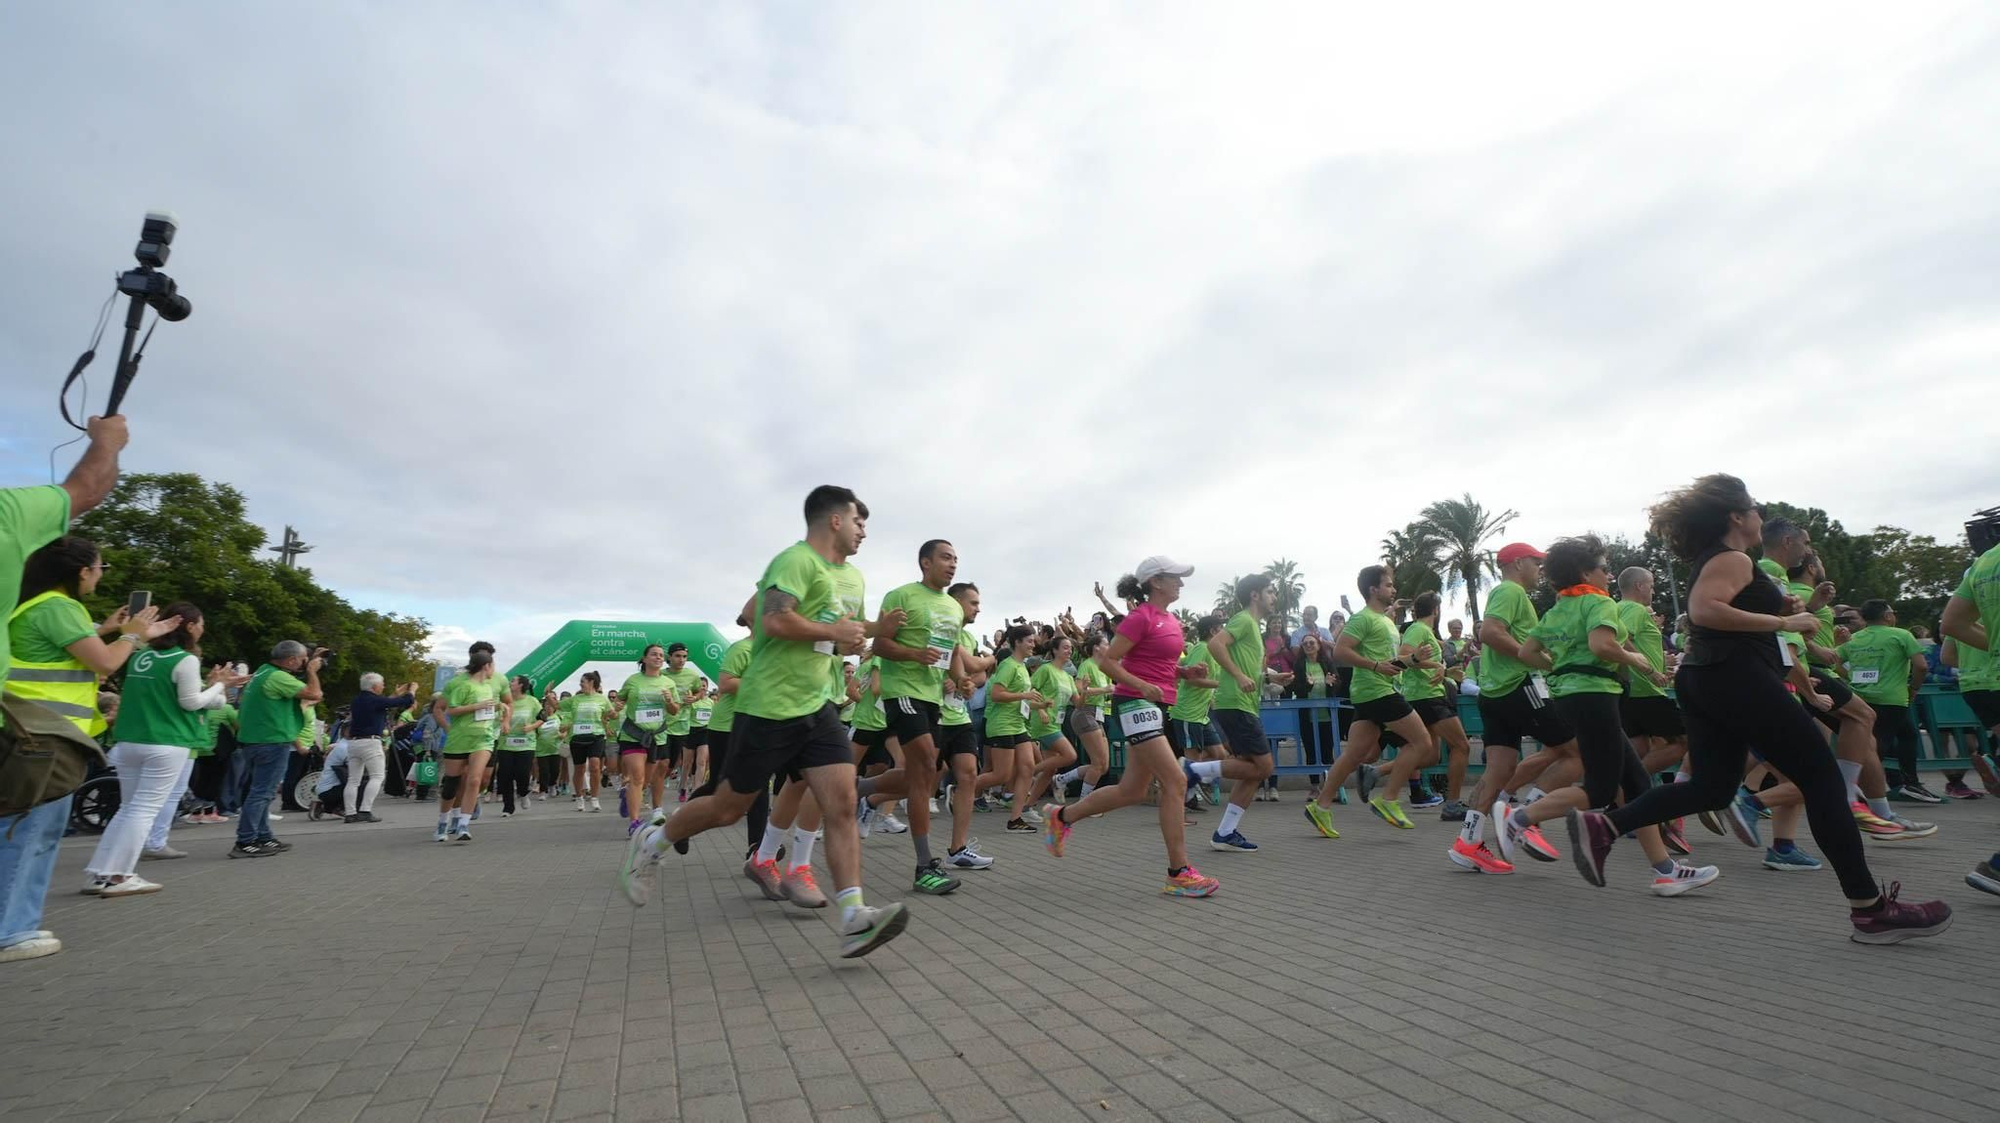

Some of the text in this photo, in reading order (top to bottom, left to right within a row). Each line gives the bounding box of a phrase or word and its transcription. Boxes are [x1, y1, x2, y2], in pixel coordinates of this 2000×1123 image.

[591, 629, 646, 638] En marcha
[591, 639, 625, 647] contra
[602, 647, 639, 655] cáncer
[1133, 711, 1158, 724] 0038
